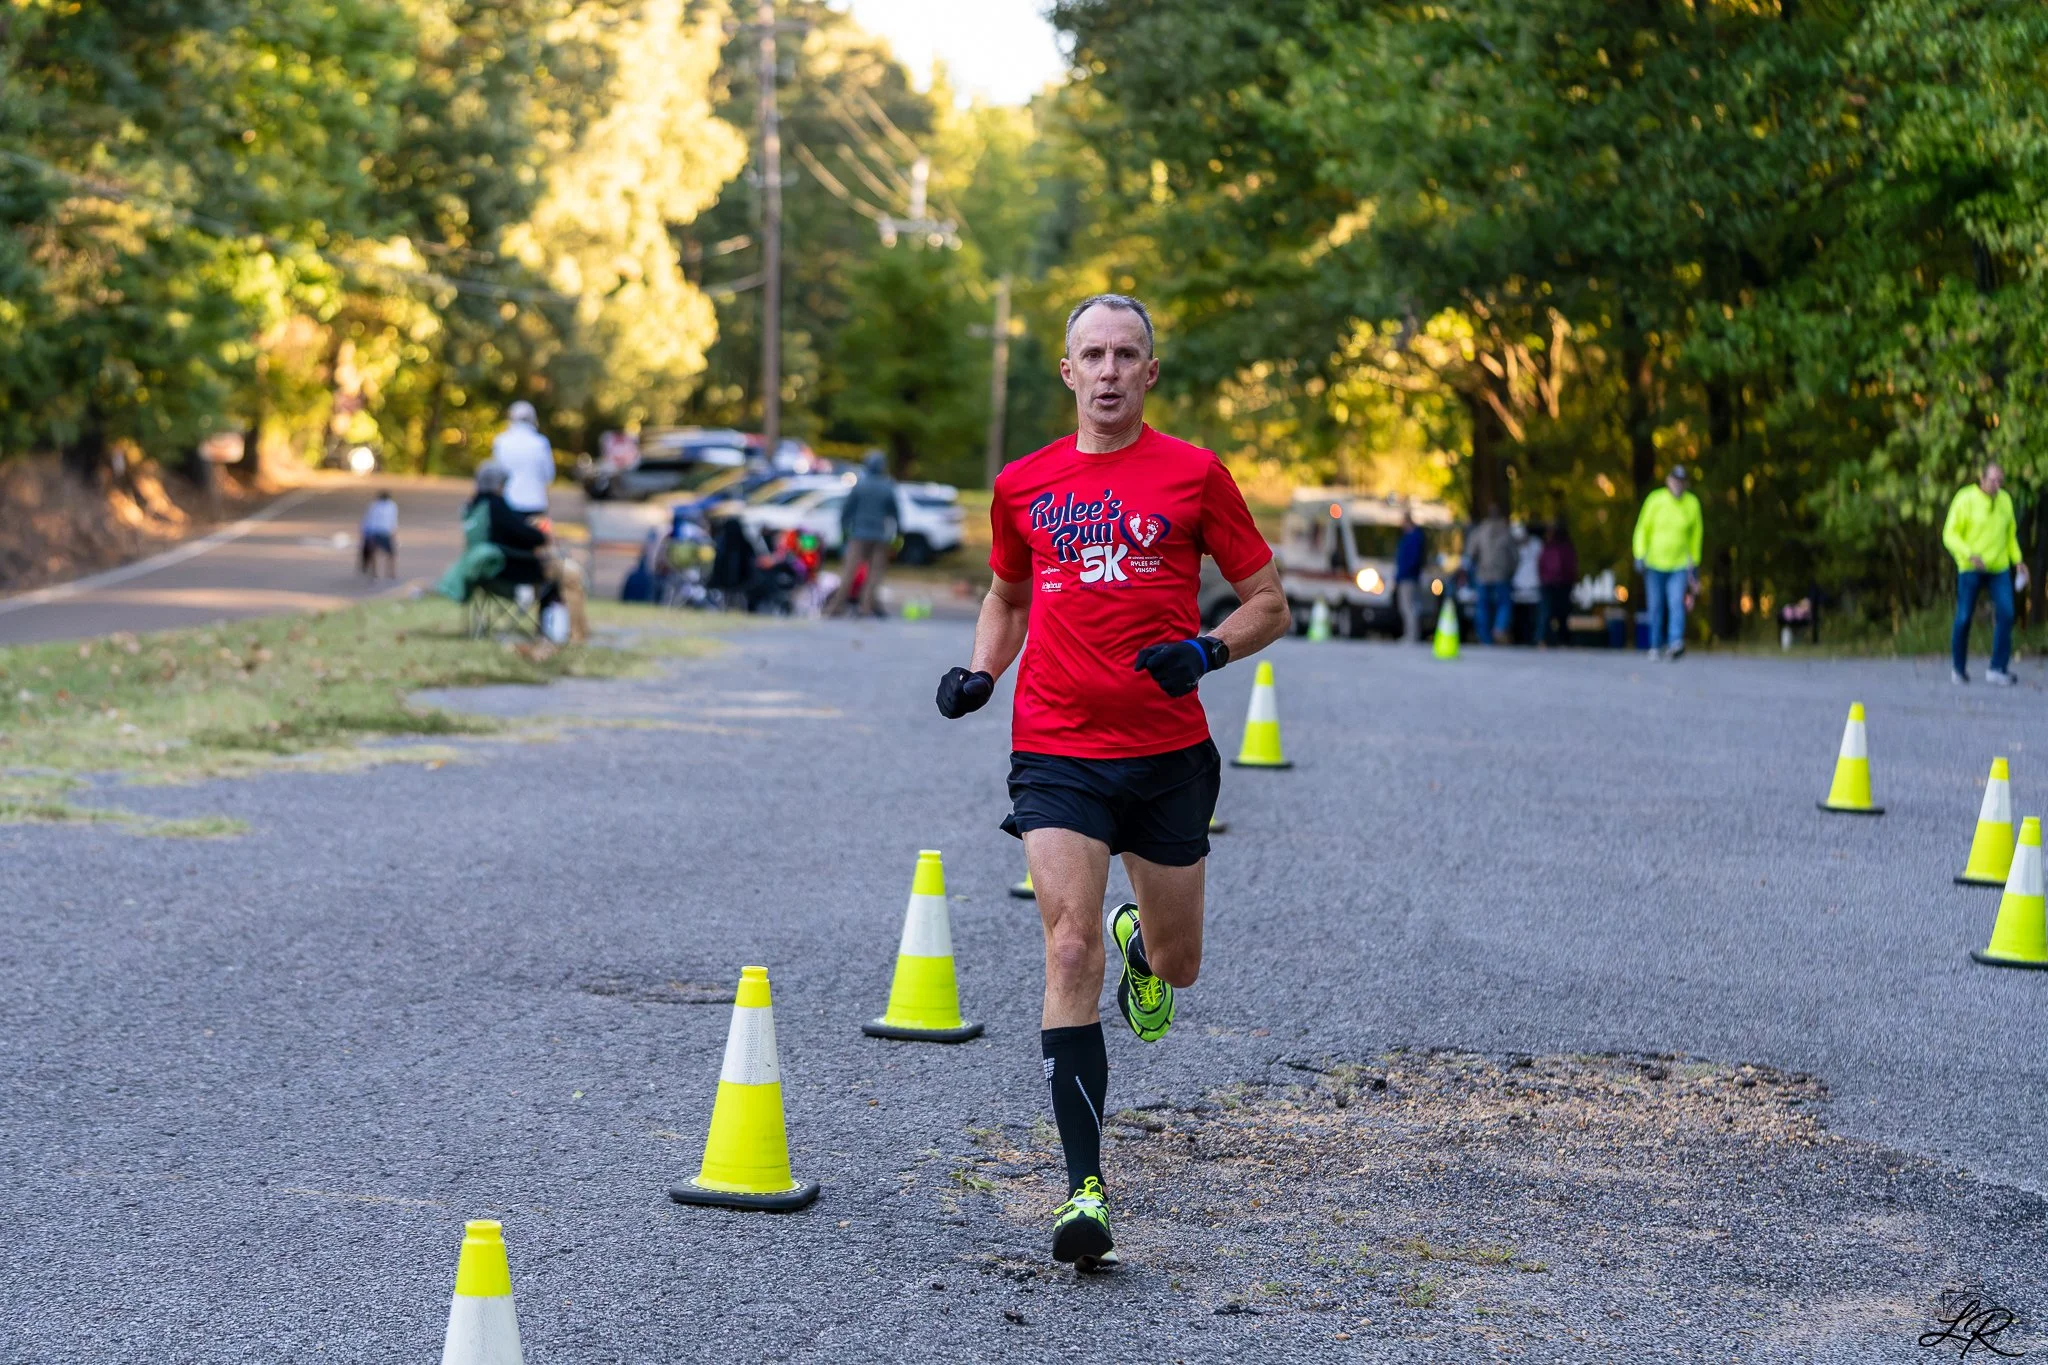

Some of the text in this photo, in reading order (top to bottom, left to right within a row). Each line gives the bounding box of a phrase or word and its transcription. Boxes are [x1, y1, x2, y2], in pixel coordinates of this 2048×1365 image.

[1029, 489, 1122, 533] Rylee's
[1052, 523, 1113, 563] Run
[1080, 544, 1128, 583] 5K
